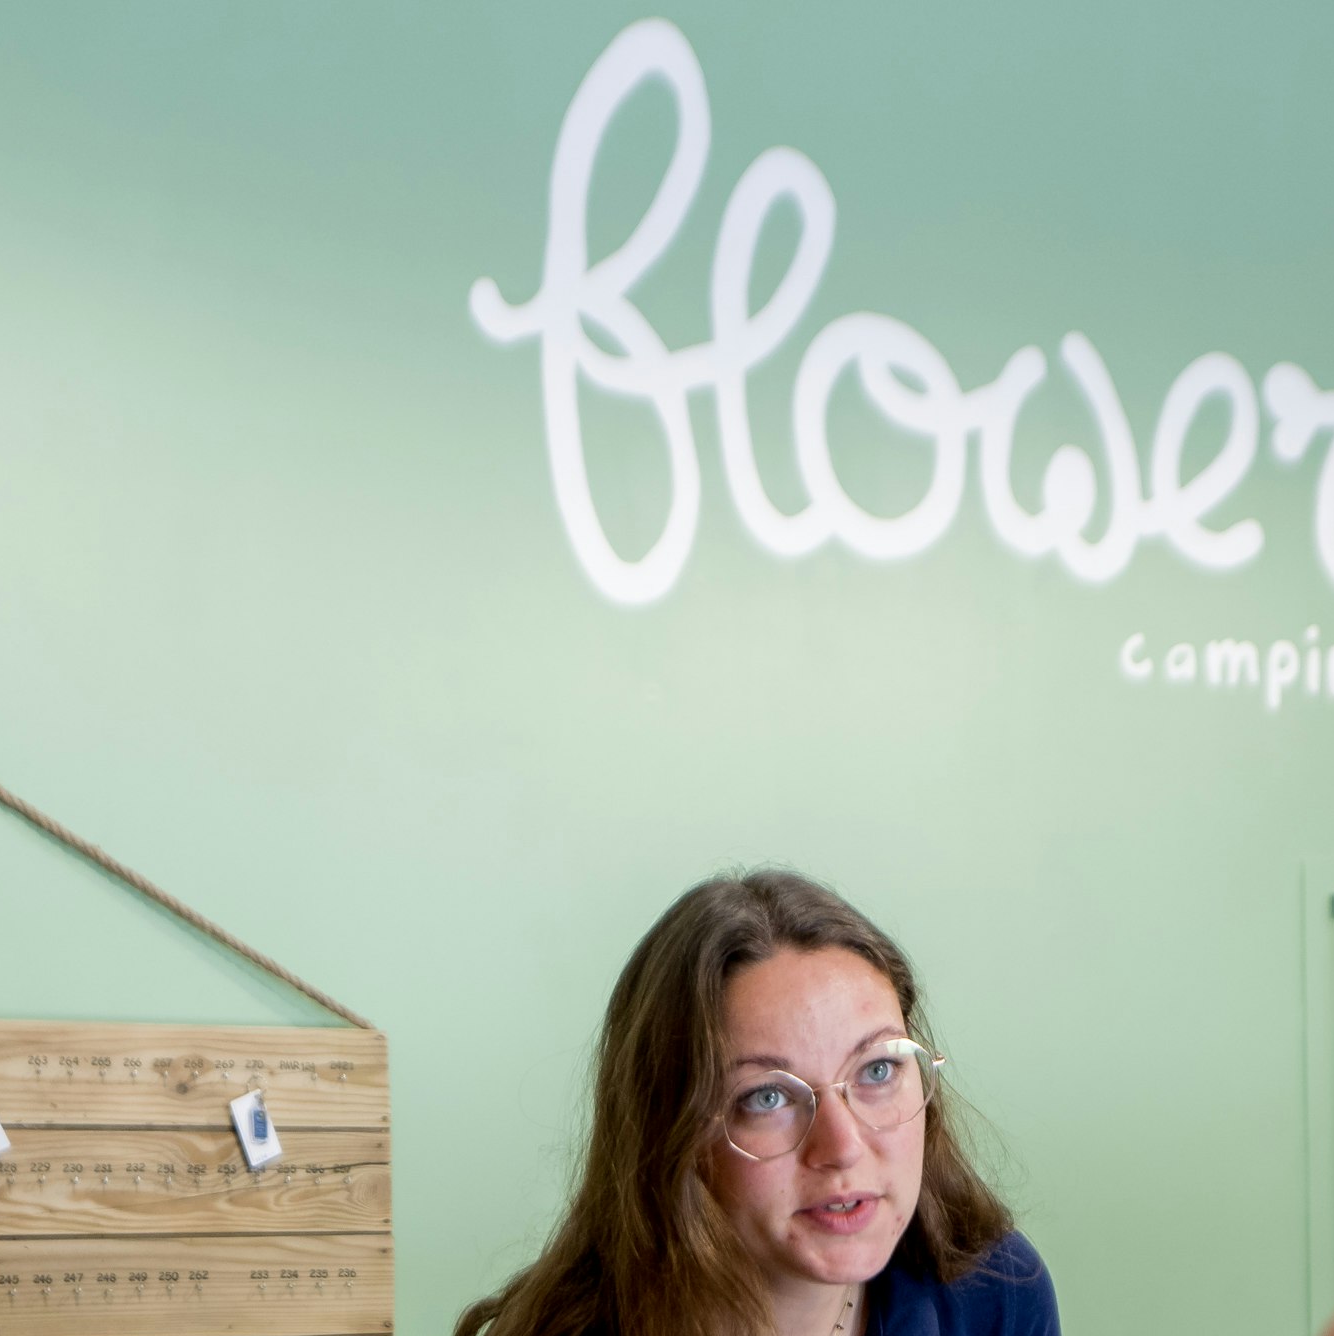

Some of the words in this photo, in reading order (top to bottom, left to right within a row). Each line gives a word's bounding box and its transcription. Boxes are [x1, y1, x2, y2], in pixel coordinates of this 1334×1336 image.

[28, 1055, 48, 1066] 263
[59, 1055, 79, 1066] 264
[123, 1057, 142, 1067] 266
[183, 1058, 204, 1069] 268
[214, 1059, 235, 1069] 269
[30, 1162, 51, 1173] 229
[62, 1163, 83, 1173] 230
[94, 1162, 112, 1173] 231
[126, 1162, 145, 1173] 232
[157, 1163, 175, 1174] 251
[217, 1164, 237, 1174] 253
[33, 1274, 53, 1284] 246
[63, 1272, 84, 1283] 247
[128, 1272, 148, 1282] 249
[158, 1271, 179, 1281] 250
[188, 1270, 209, 1280] 262
[250, 1269, 269, 1279] 233
[280, 1269, 299, 1279] 234
[309, 1269, 328, 1278] 235
[338, 1268, 356, 1278] 236
